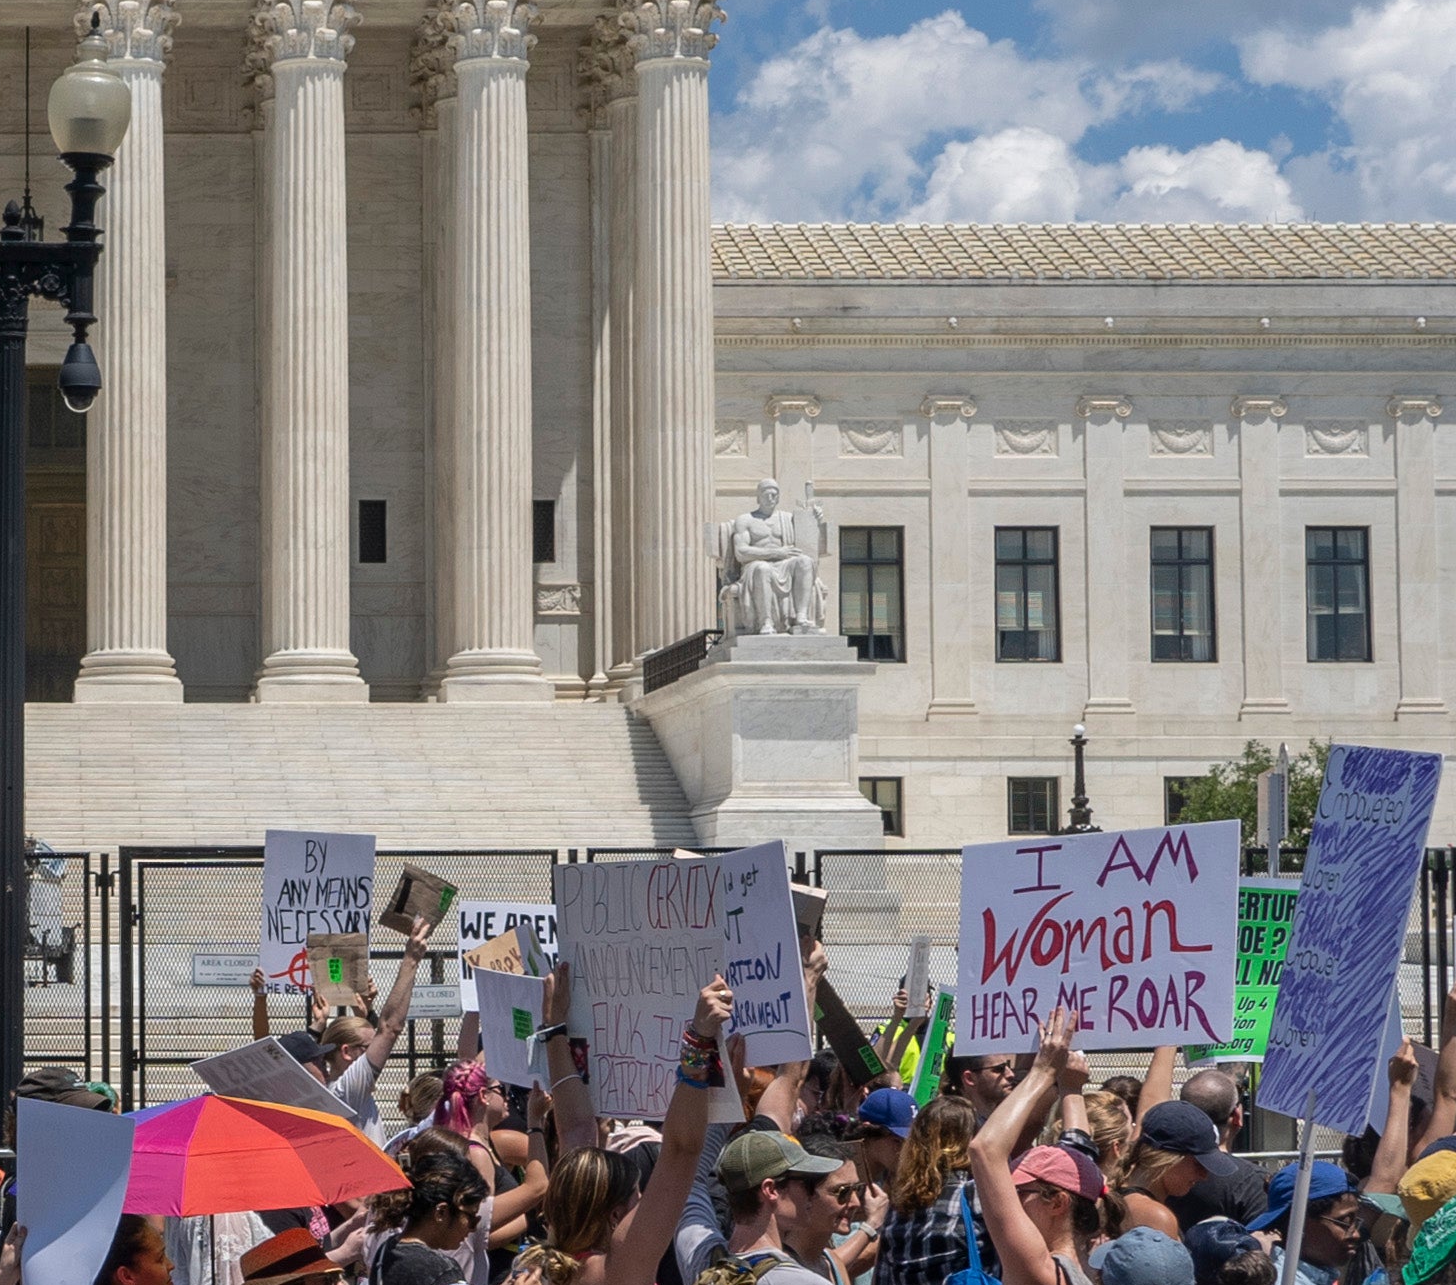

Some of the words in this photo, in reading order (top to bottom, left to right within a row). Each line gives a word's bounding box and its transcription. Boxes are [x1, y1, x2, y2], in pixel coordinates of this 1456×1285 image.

[1319, 747, 1412, 832] Empowered
[304, 839, 327, 875] BY
[1013, 843, 1063, 894] I
[1096, 830, 1199, 888] AM
[277, 877, 313, 907] ANY
[315, 876, 373, 909] MEANS
[562, 864, 643, 936] PUBLIC
[647, 863, 720, 930] CERVIX
[740, 863, 759, 897] get
[265, 904, 372, 945] NECESSARY
[460, 911, 496, 940] WE
[1238, 891, 1299, 923] ERTUR
[981, 890, 1213, 987] Woman
[1237, 925, 1267, 955] OE
[201, 959, 222, 967] AREA
[224, 959, 254, 967] CLOSED
[725, 942, 782, 988] RTION
[427, 990, 456, 999] CLOSED
[970, 986, 1041, 1040] HEAR
[1056, 981, 1098, 1033] ME
[1107, 970, 1223, 1044] ROAR
[653, 1015, 693, 1058] TH
[598, 1056, 676, 1112] PATRIARC
